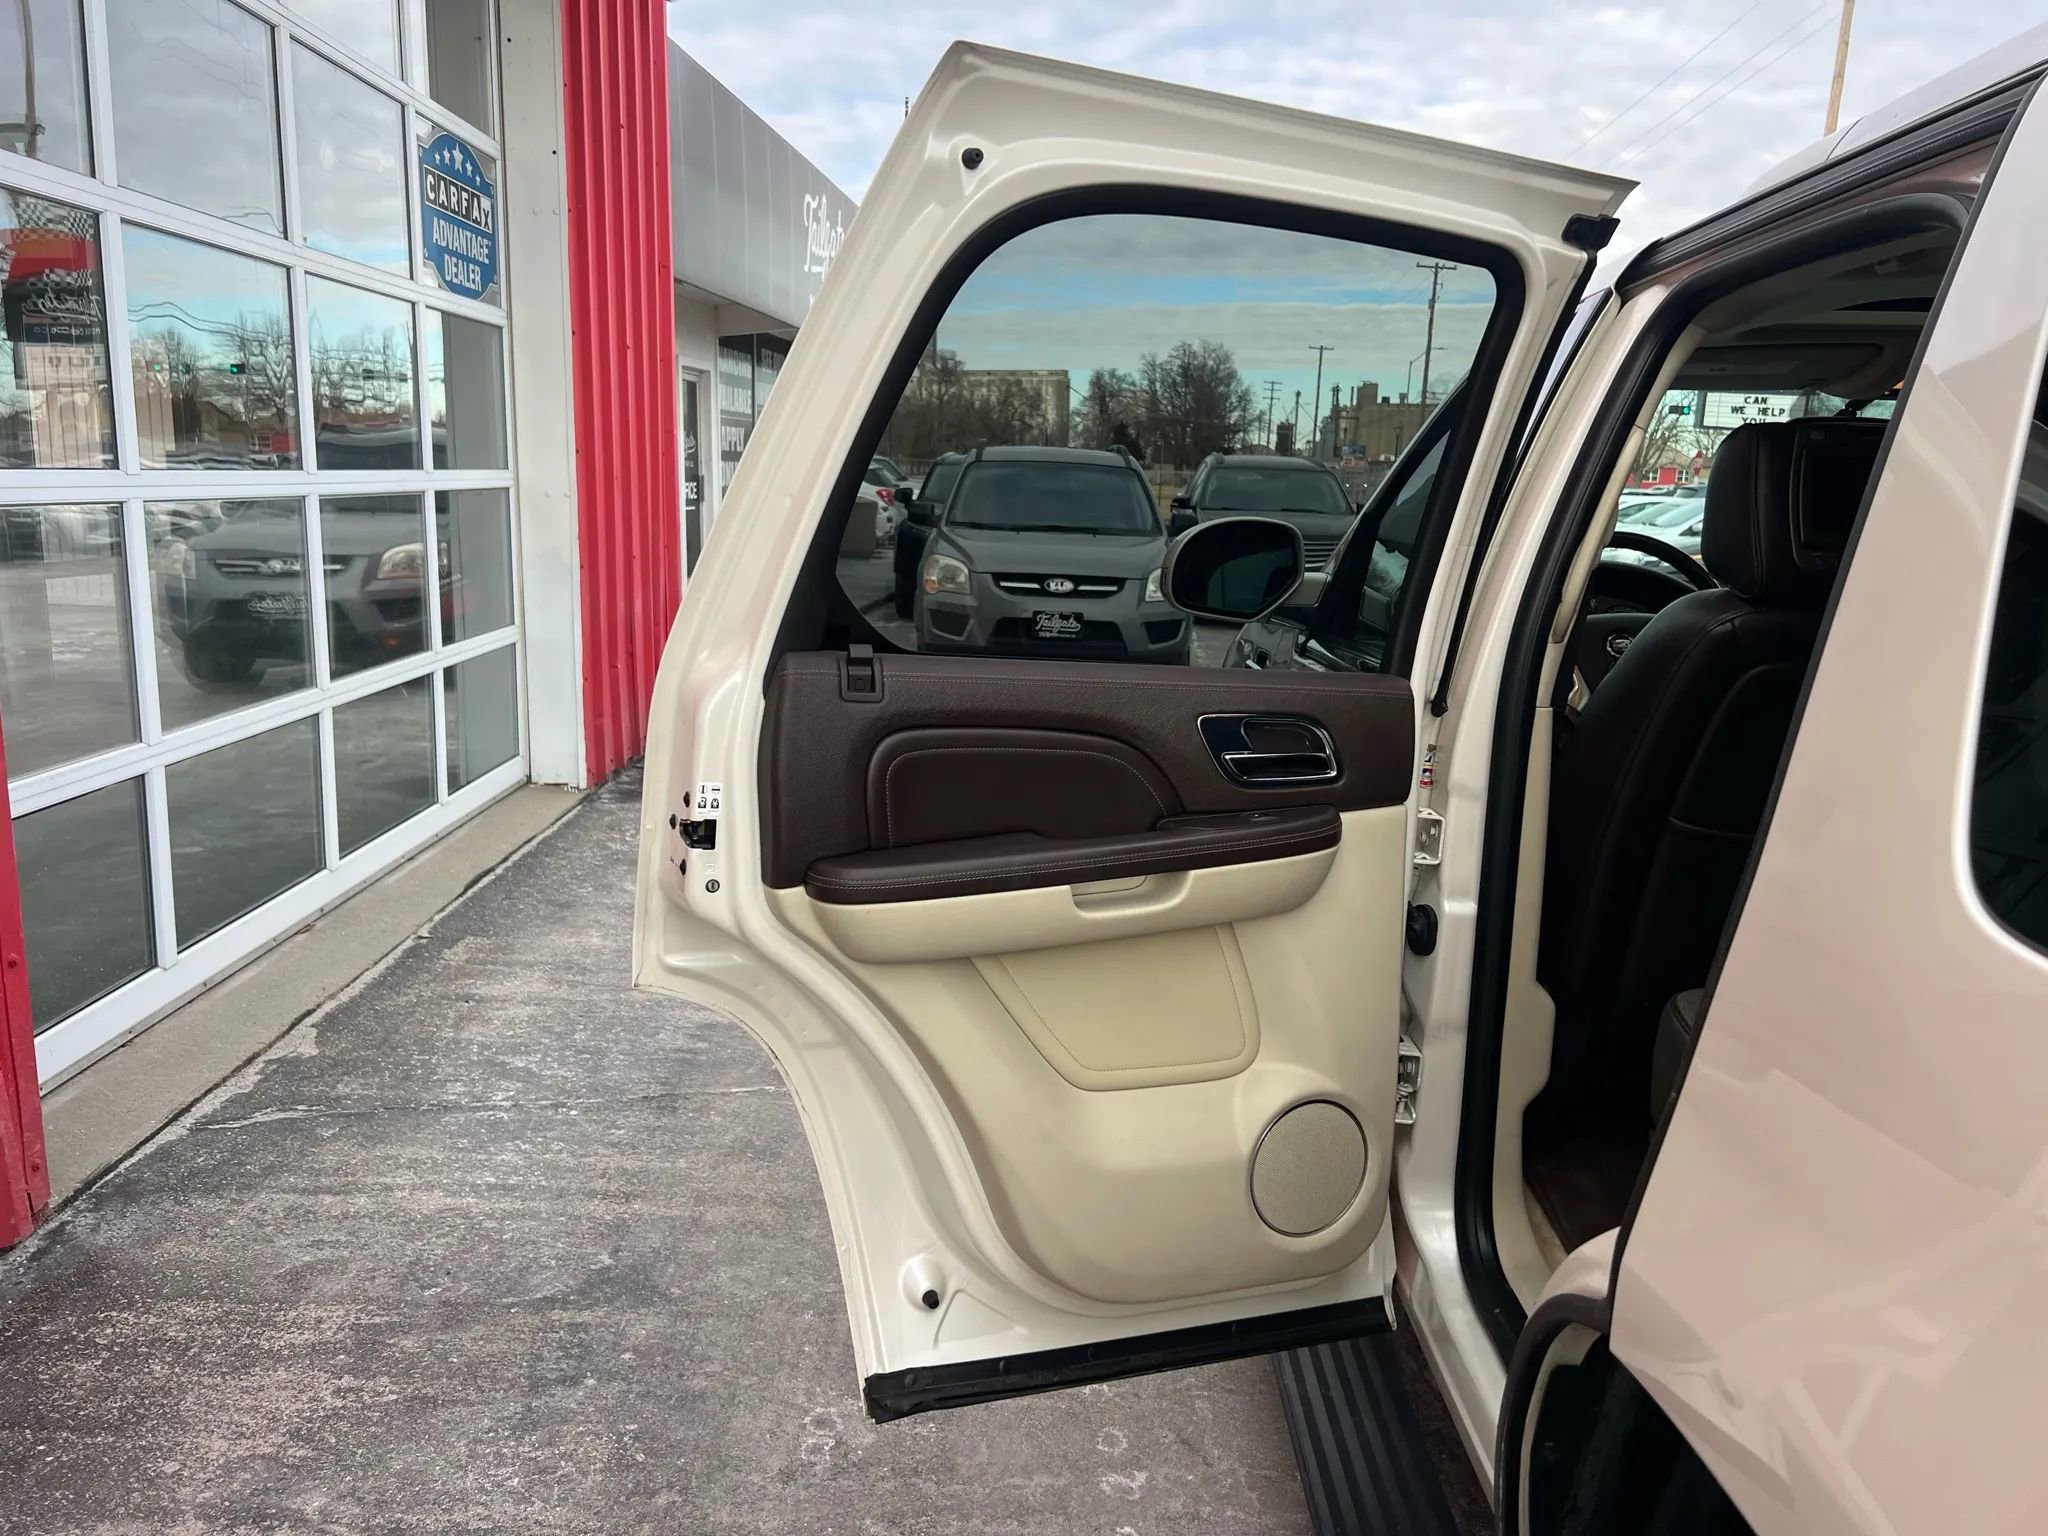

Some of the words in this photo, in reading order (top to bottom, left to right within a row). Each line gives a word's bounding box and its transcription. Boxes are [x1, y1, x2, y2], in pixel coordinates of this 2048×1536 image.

[427, 173, 490, 229] CARFAX
[433, 216, 490, 265] ADVANTAGE
[444, 254, 482, 292] DEALER
[1731, 405, 1746, 415] WE
[1757, 407, 1786, 417] HELP
[1744, 396, 1768, 405] CAN
[721, 425, 745, 452] APPLY
